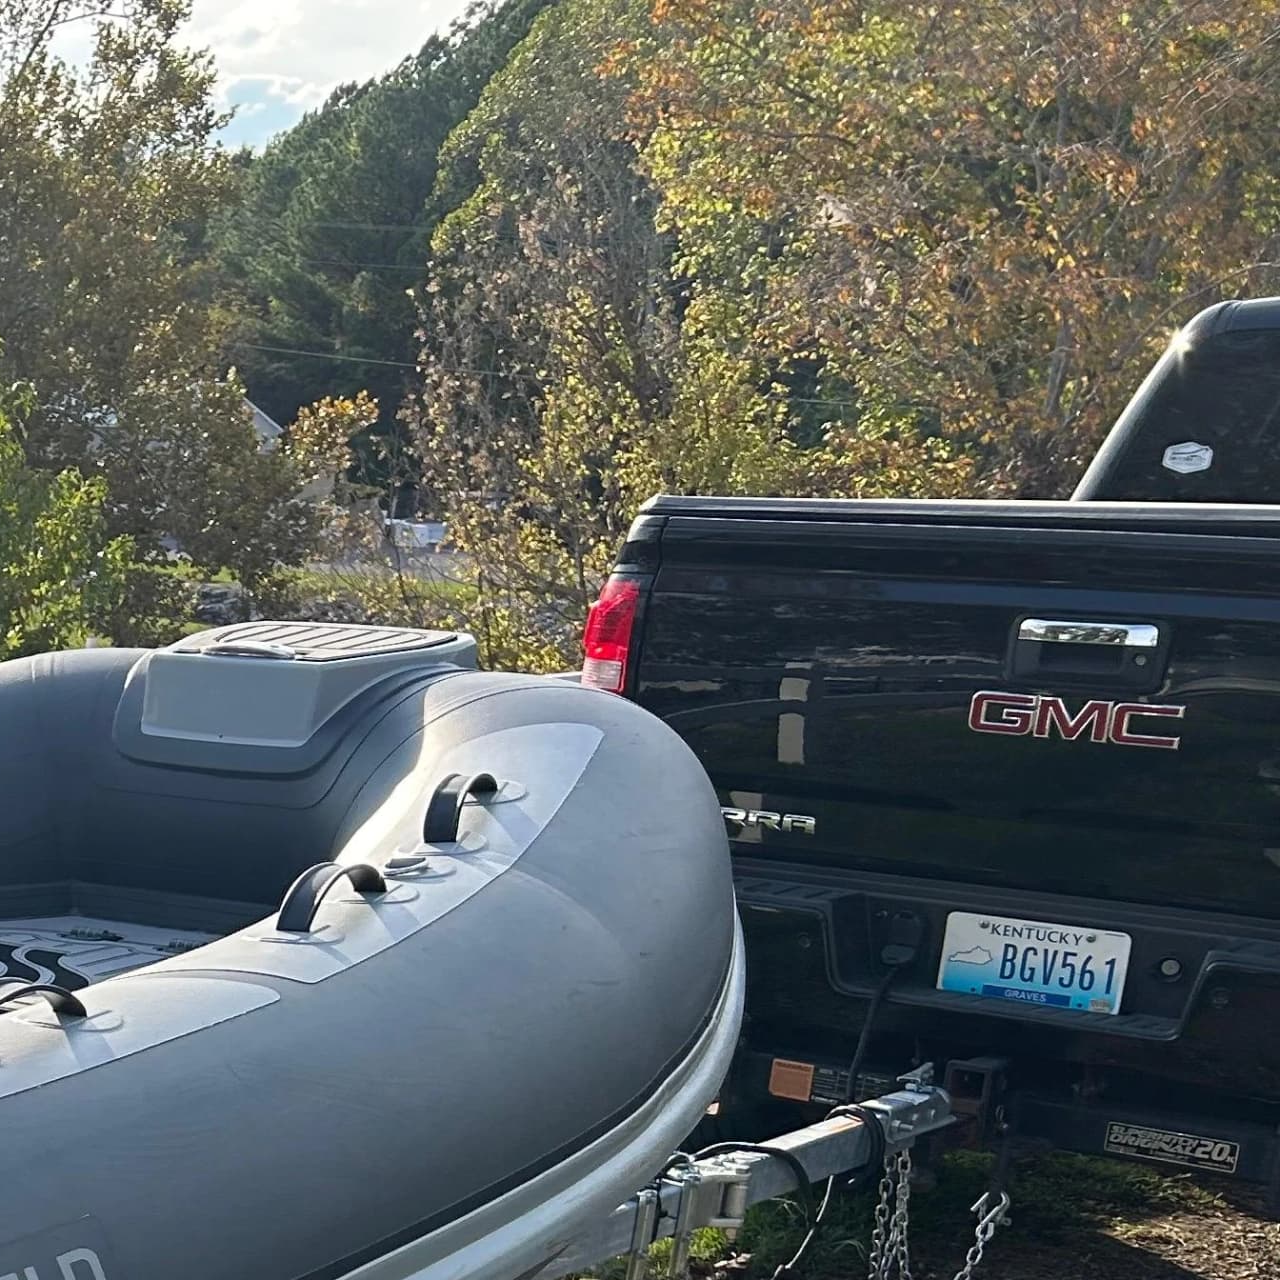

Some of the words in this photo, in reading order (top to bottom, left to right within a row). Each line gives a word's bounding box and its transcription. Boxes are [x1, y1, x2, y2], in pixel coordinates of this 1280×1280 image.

[968, 690, 1186, 750] GMC
[990, 923, 1084, 947] KENTUCKY
[999, 943, 1117, 995] BGV561
[1004, 989, 1048, 1003] GRAVES
[1108, 1133, 1197, 1157] ORIGINAL
